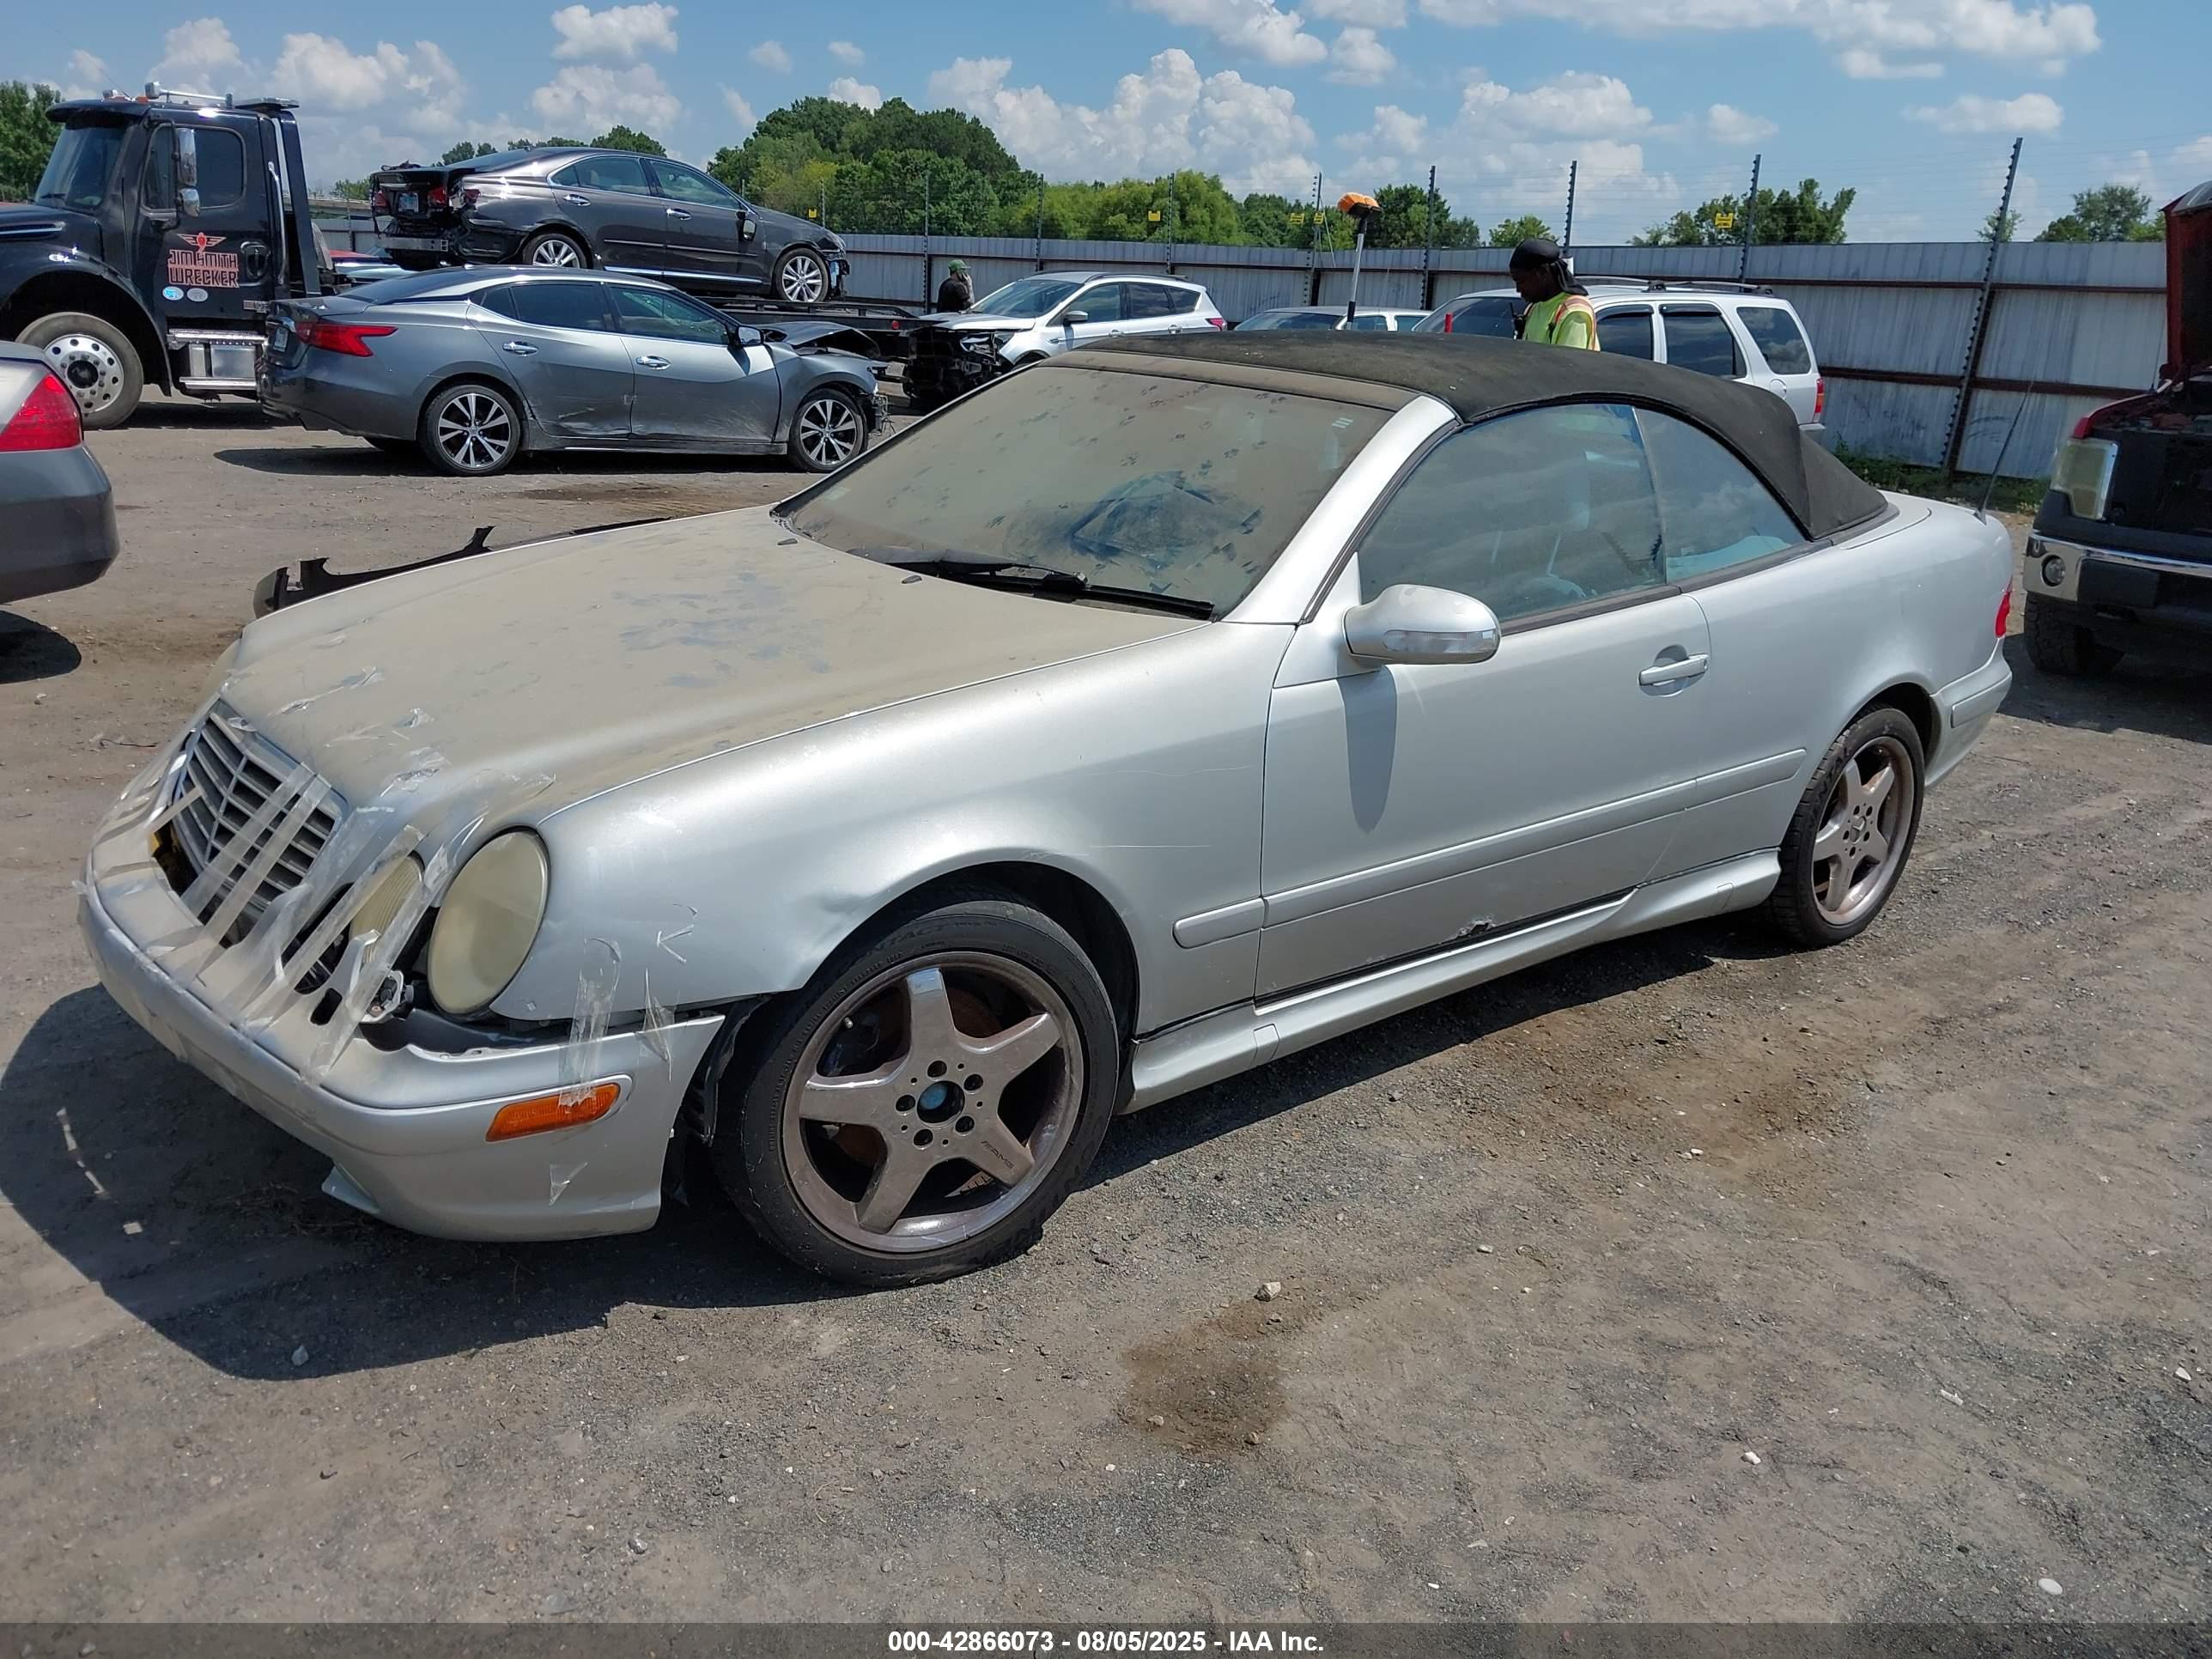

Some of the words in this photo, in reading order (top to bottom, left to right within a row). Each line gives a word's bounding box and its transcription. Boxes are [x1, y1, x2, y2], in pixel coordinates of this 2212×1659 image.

[167, 249, 195, 267] JIM
[196, 251, 239, 270] SMITH
[168, 266, 240, 288] WRECKER
